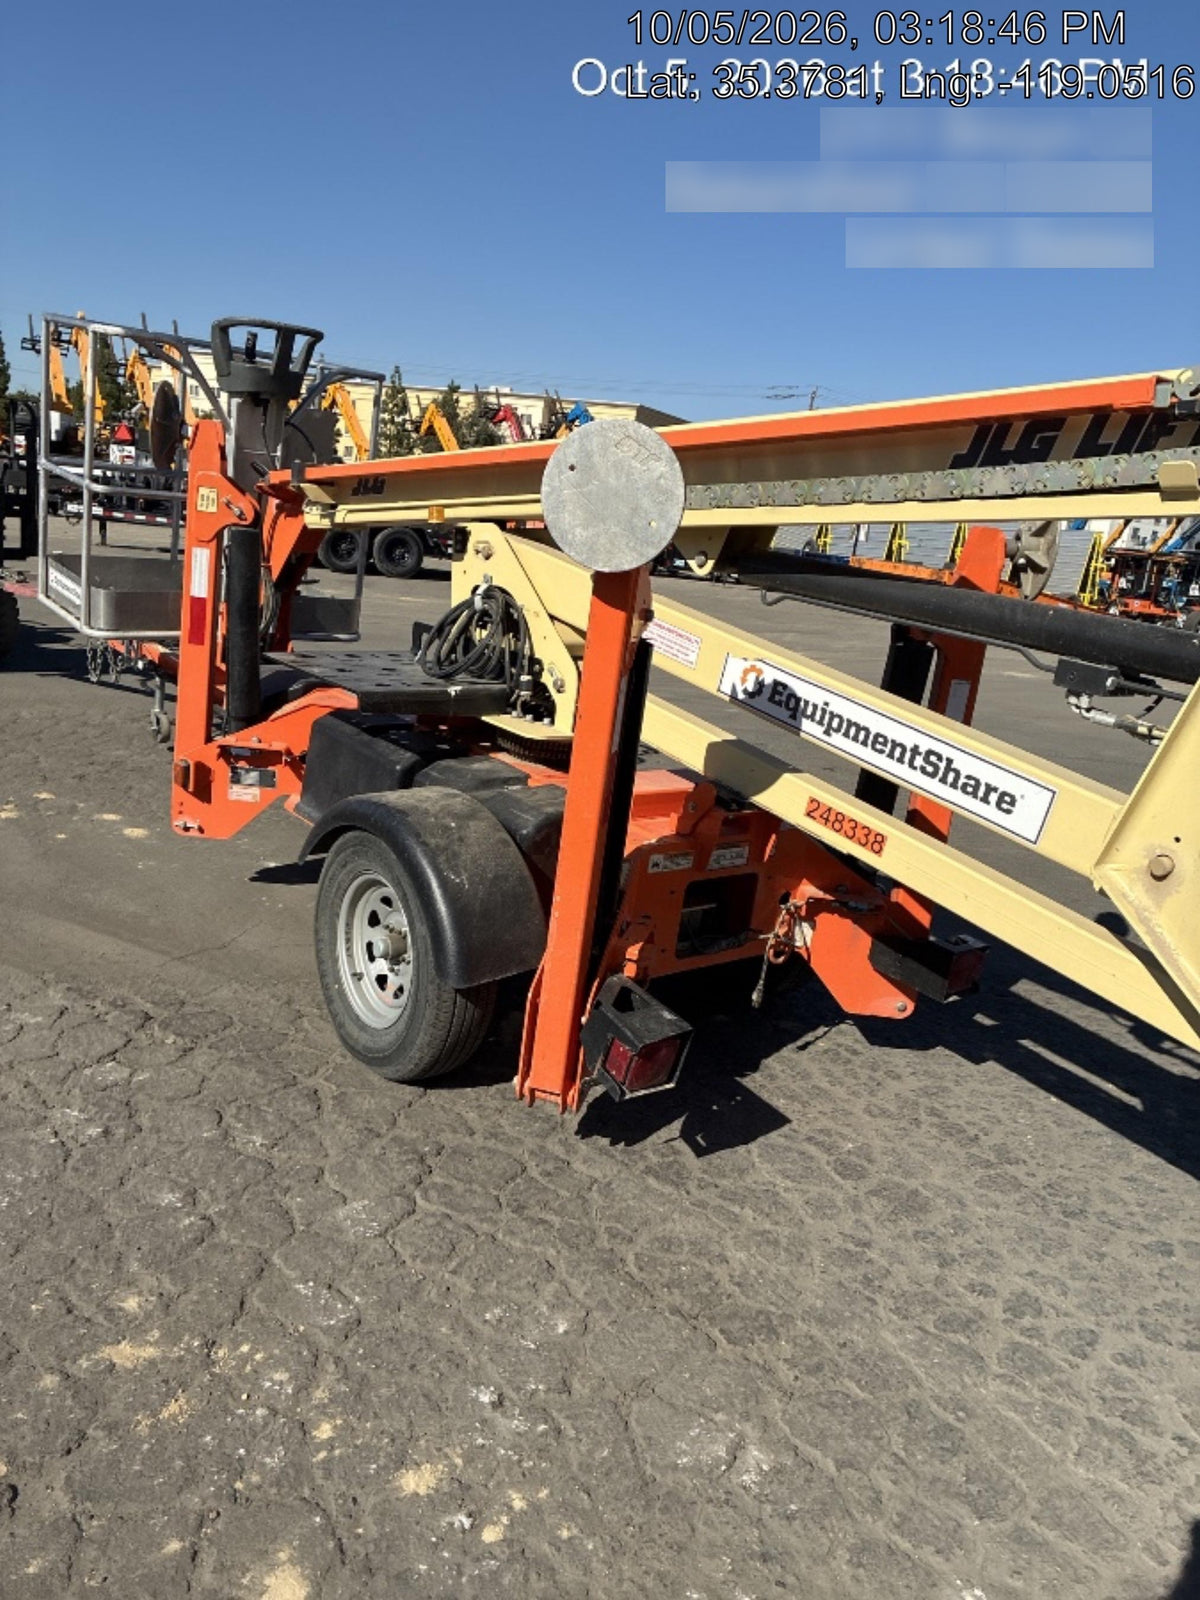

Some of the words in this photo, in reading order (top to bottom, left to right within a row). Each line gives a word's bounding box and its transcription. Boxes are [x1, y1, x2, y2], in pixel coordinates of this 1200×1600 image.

[948, 418, 1068, 470] JLG
[1072, 411, 1200, 459] LIF
[768, 677, 1019, 816] EquipmentShare
[804, 797, 888, 857] 248338
